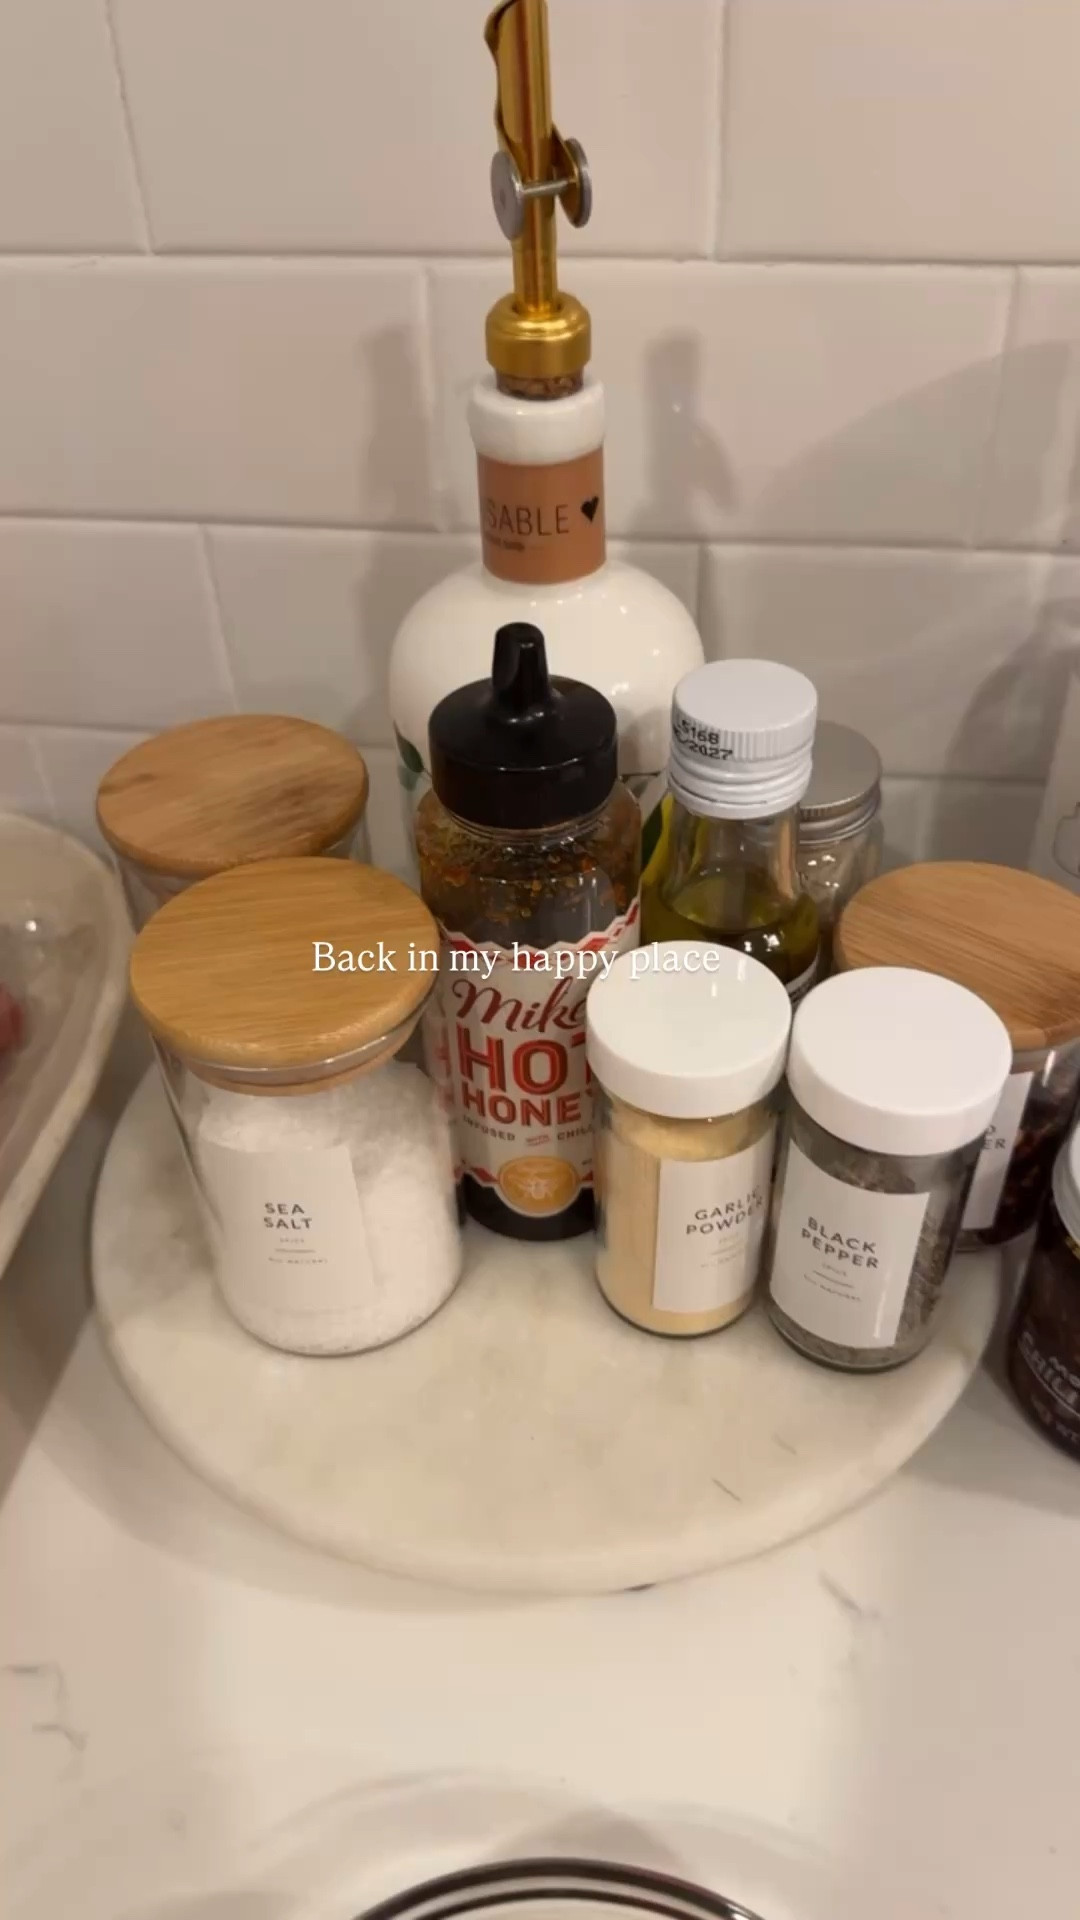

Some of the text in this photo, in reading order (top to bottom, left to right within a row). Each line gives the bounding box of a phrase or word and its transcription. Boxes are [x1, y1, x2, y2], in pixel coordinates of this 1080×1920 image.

[264, 1202, 305, 1215] SEA
[263, 1216, 313, 1230] SALT
[808, 1216, 877, 1254] BLACK
[801, 1227, 880, 1269] PEPPER
